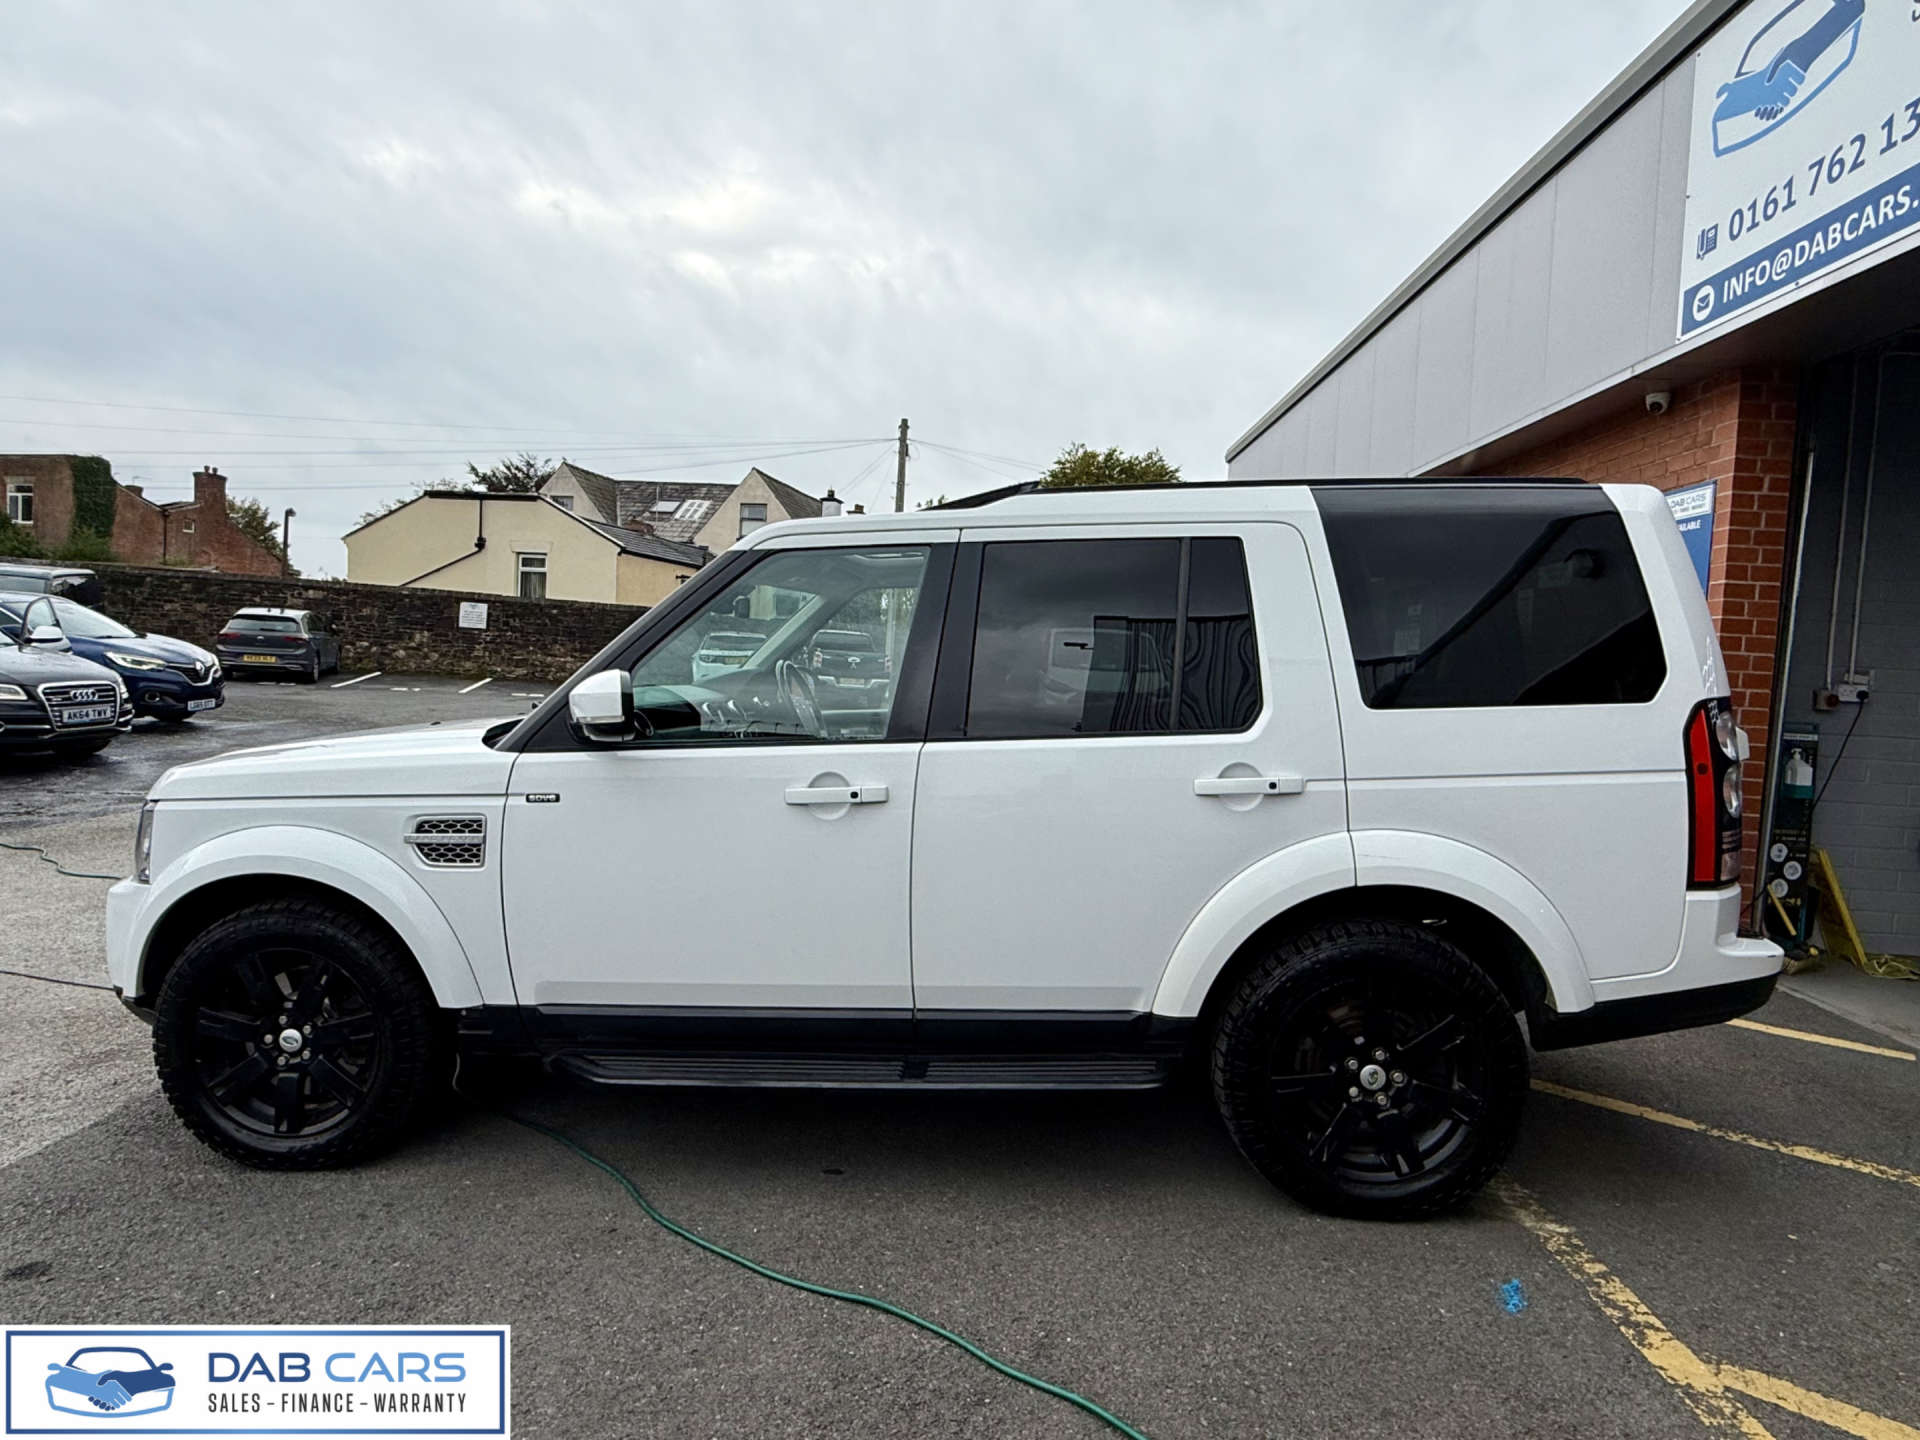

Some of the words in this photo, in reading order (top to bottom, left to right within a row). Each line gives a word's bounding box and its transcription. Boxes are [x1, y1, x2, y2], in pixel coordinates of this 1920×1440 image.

[1729, 176, 1797, 241] 0161
[1808, 133, 1866, 196] 762
[67, 709, 90, 720] AK64
